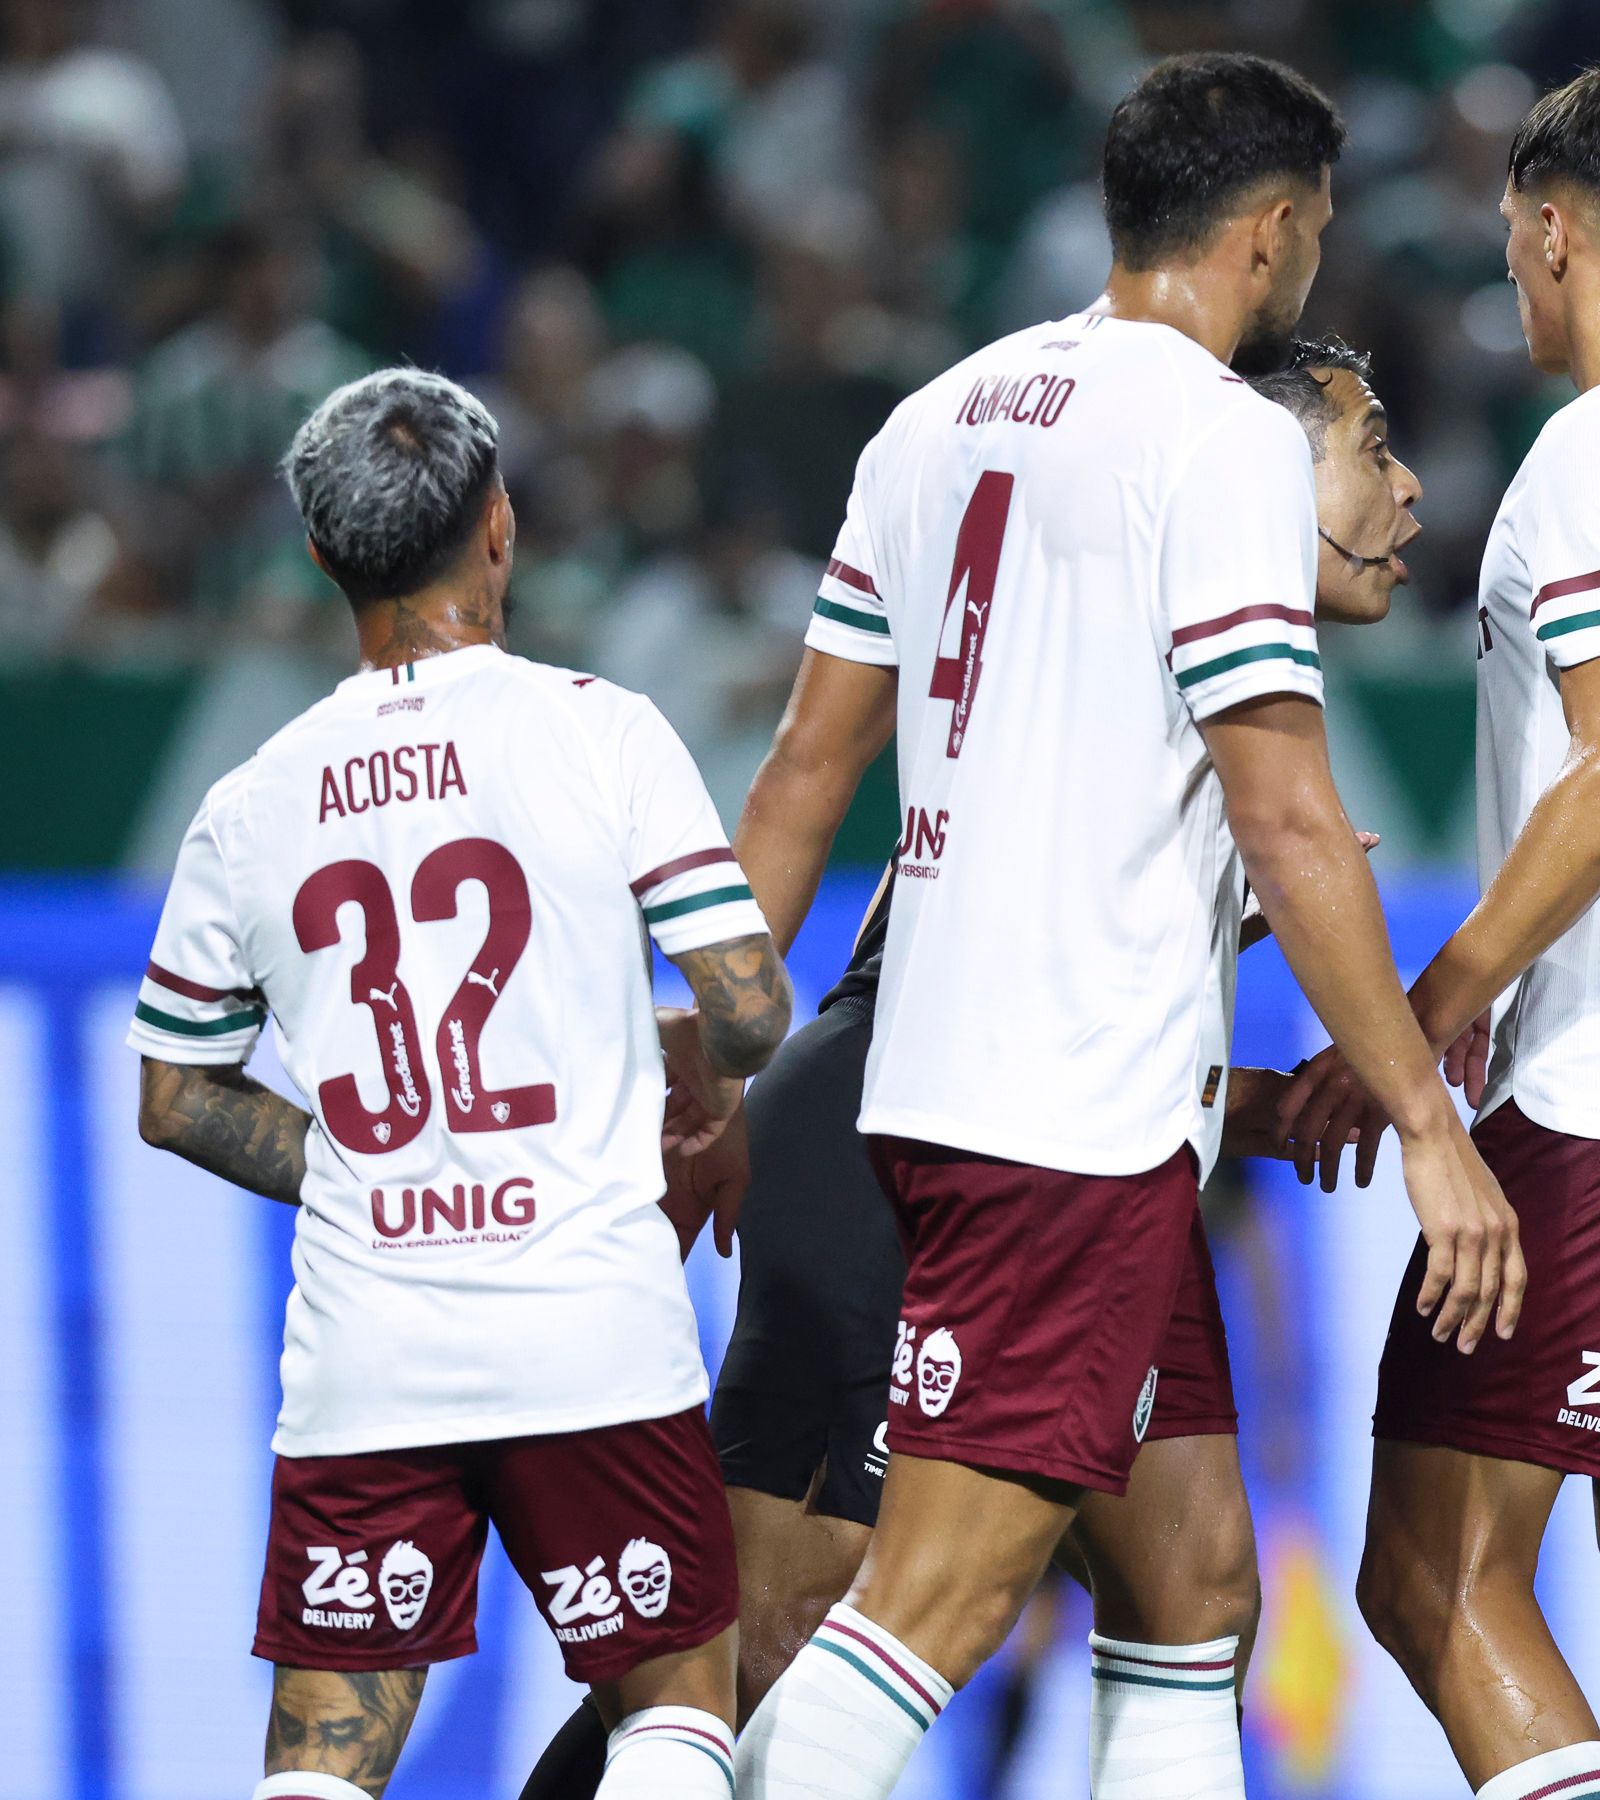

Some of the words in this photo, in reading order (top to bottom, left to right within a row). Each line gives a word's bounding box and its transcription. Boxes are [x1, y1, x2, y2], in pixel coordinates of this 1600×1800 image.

[955, 373, 1076, 428] IGNACIO
[928, 470, 1015, 759] 4
[318, 741, 467, 824] ACOSTA
[292, 837, 557, 1154] 32
[371, 1176, 536, 1238] UNIG
[863, 1461, 883, 1478] TIME
[301, 1546, 376, 1610] Zé
[540, 1554, 622, 1626] Zé
[302, 1607, 376, 1630] DELIVERY
[555, 1611, 624, 1642] DELIVERY
